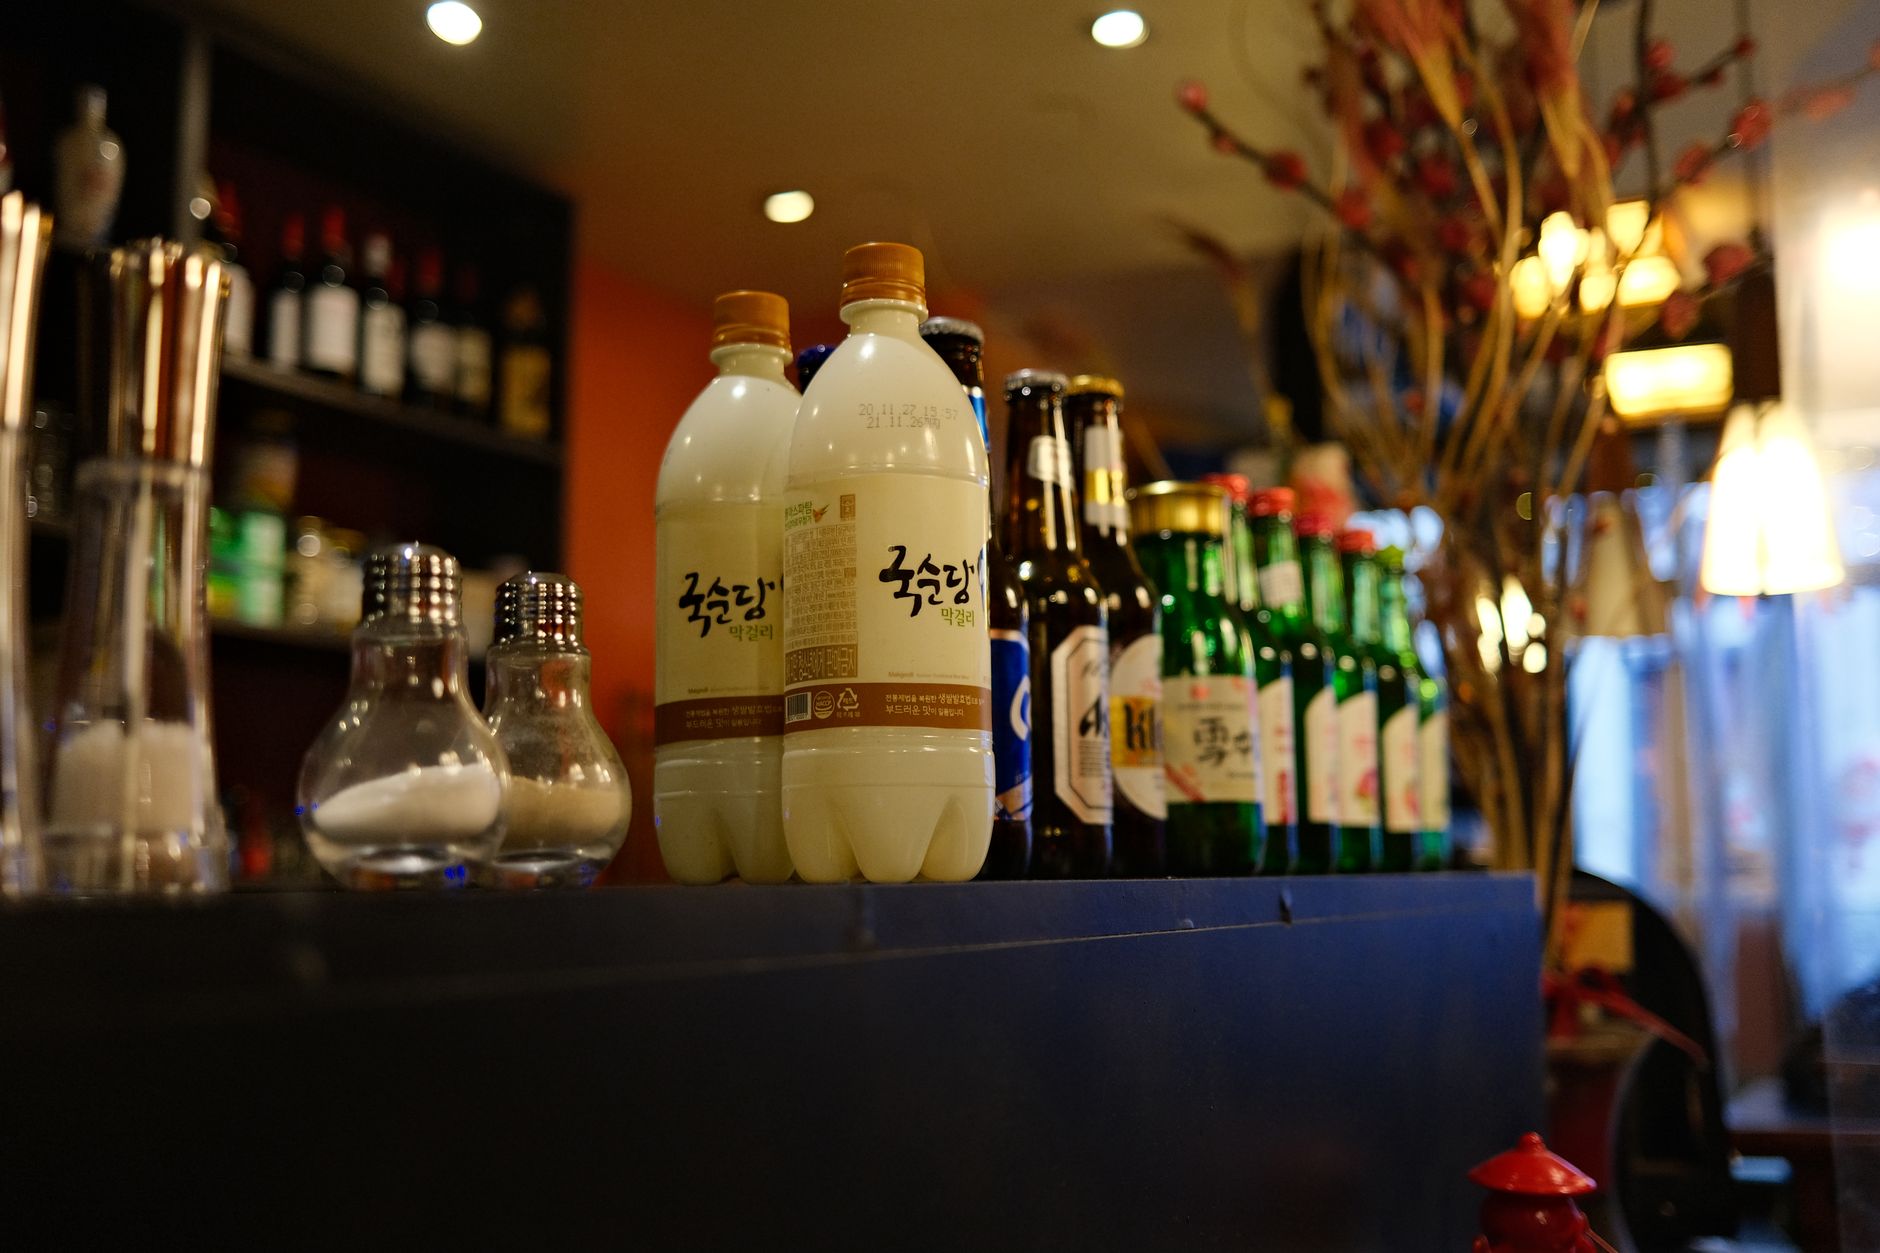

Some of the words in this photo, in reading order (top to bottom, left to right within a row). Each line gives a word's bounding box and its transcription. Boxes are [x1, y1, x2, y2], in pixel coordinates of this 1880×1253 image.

[879, 546, 975, 617] 국순당
[679, 572, 775, 638] 국순당
[941, 608, 975, 627] 막걸리
[729, 624, 773, 641] 막걸리
[885, 704, 920, 716] 부드러운
[922, 705, 937, 716] 맛이
